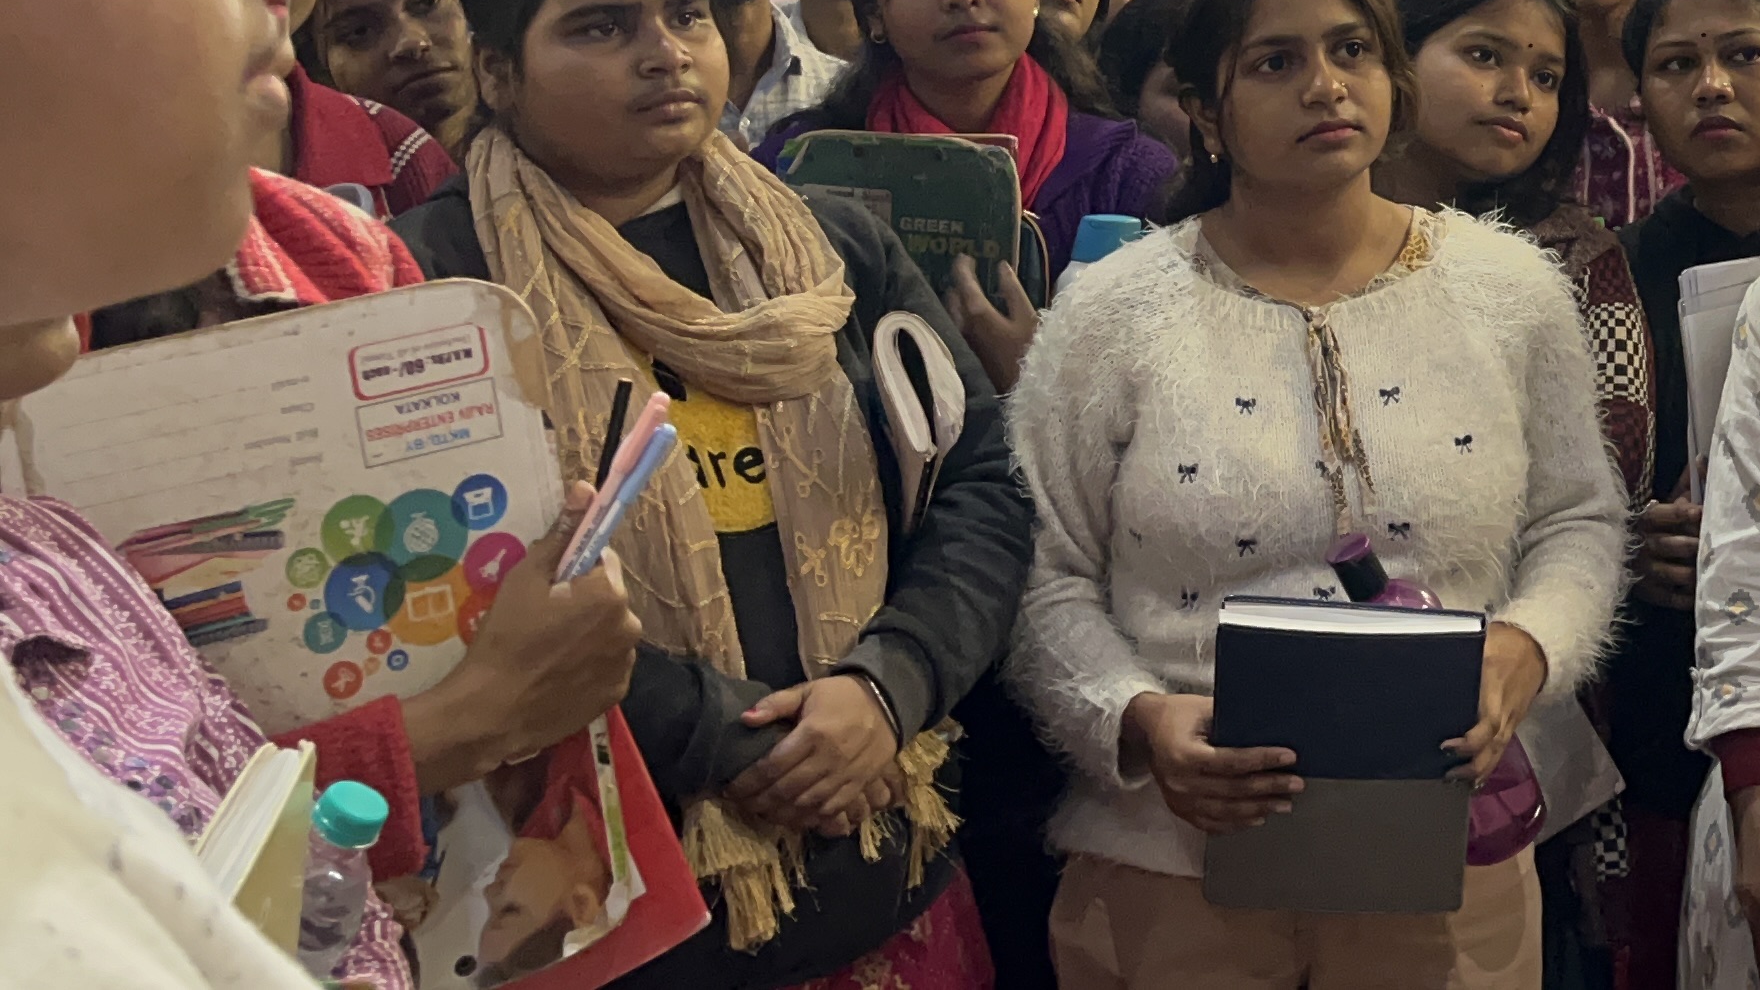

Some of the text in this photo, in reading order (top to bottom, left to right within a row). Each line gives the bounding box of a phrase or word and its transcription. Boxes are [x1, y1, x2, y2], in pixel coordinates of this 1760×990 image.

[899, 216, 965, 234] GREEN
[907, 233, 1000, 259] WORLD
[394, 391, 461, 415] KOLKATA
[365, 410, 455, 443] ENTERPRISES
[406, 438, 426, 452] BY
